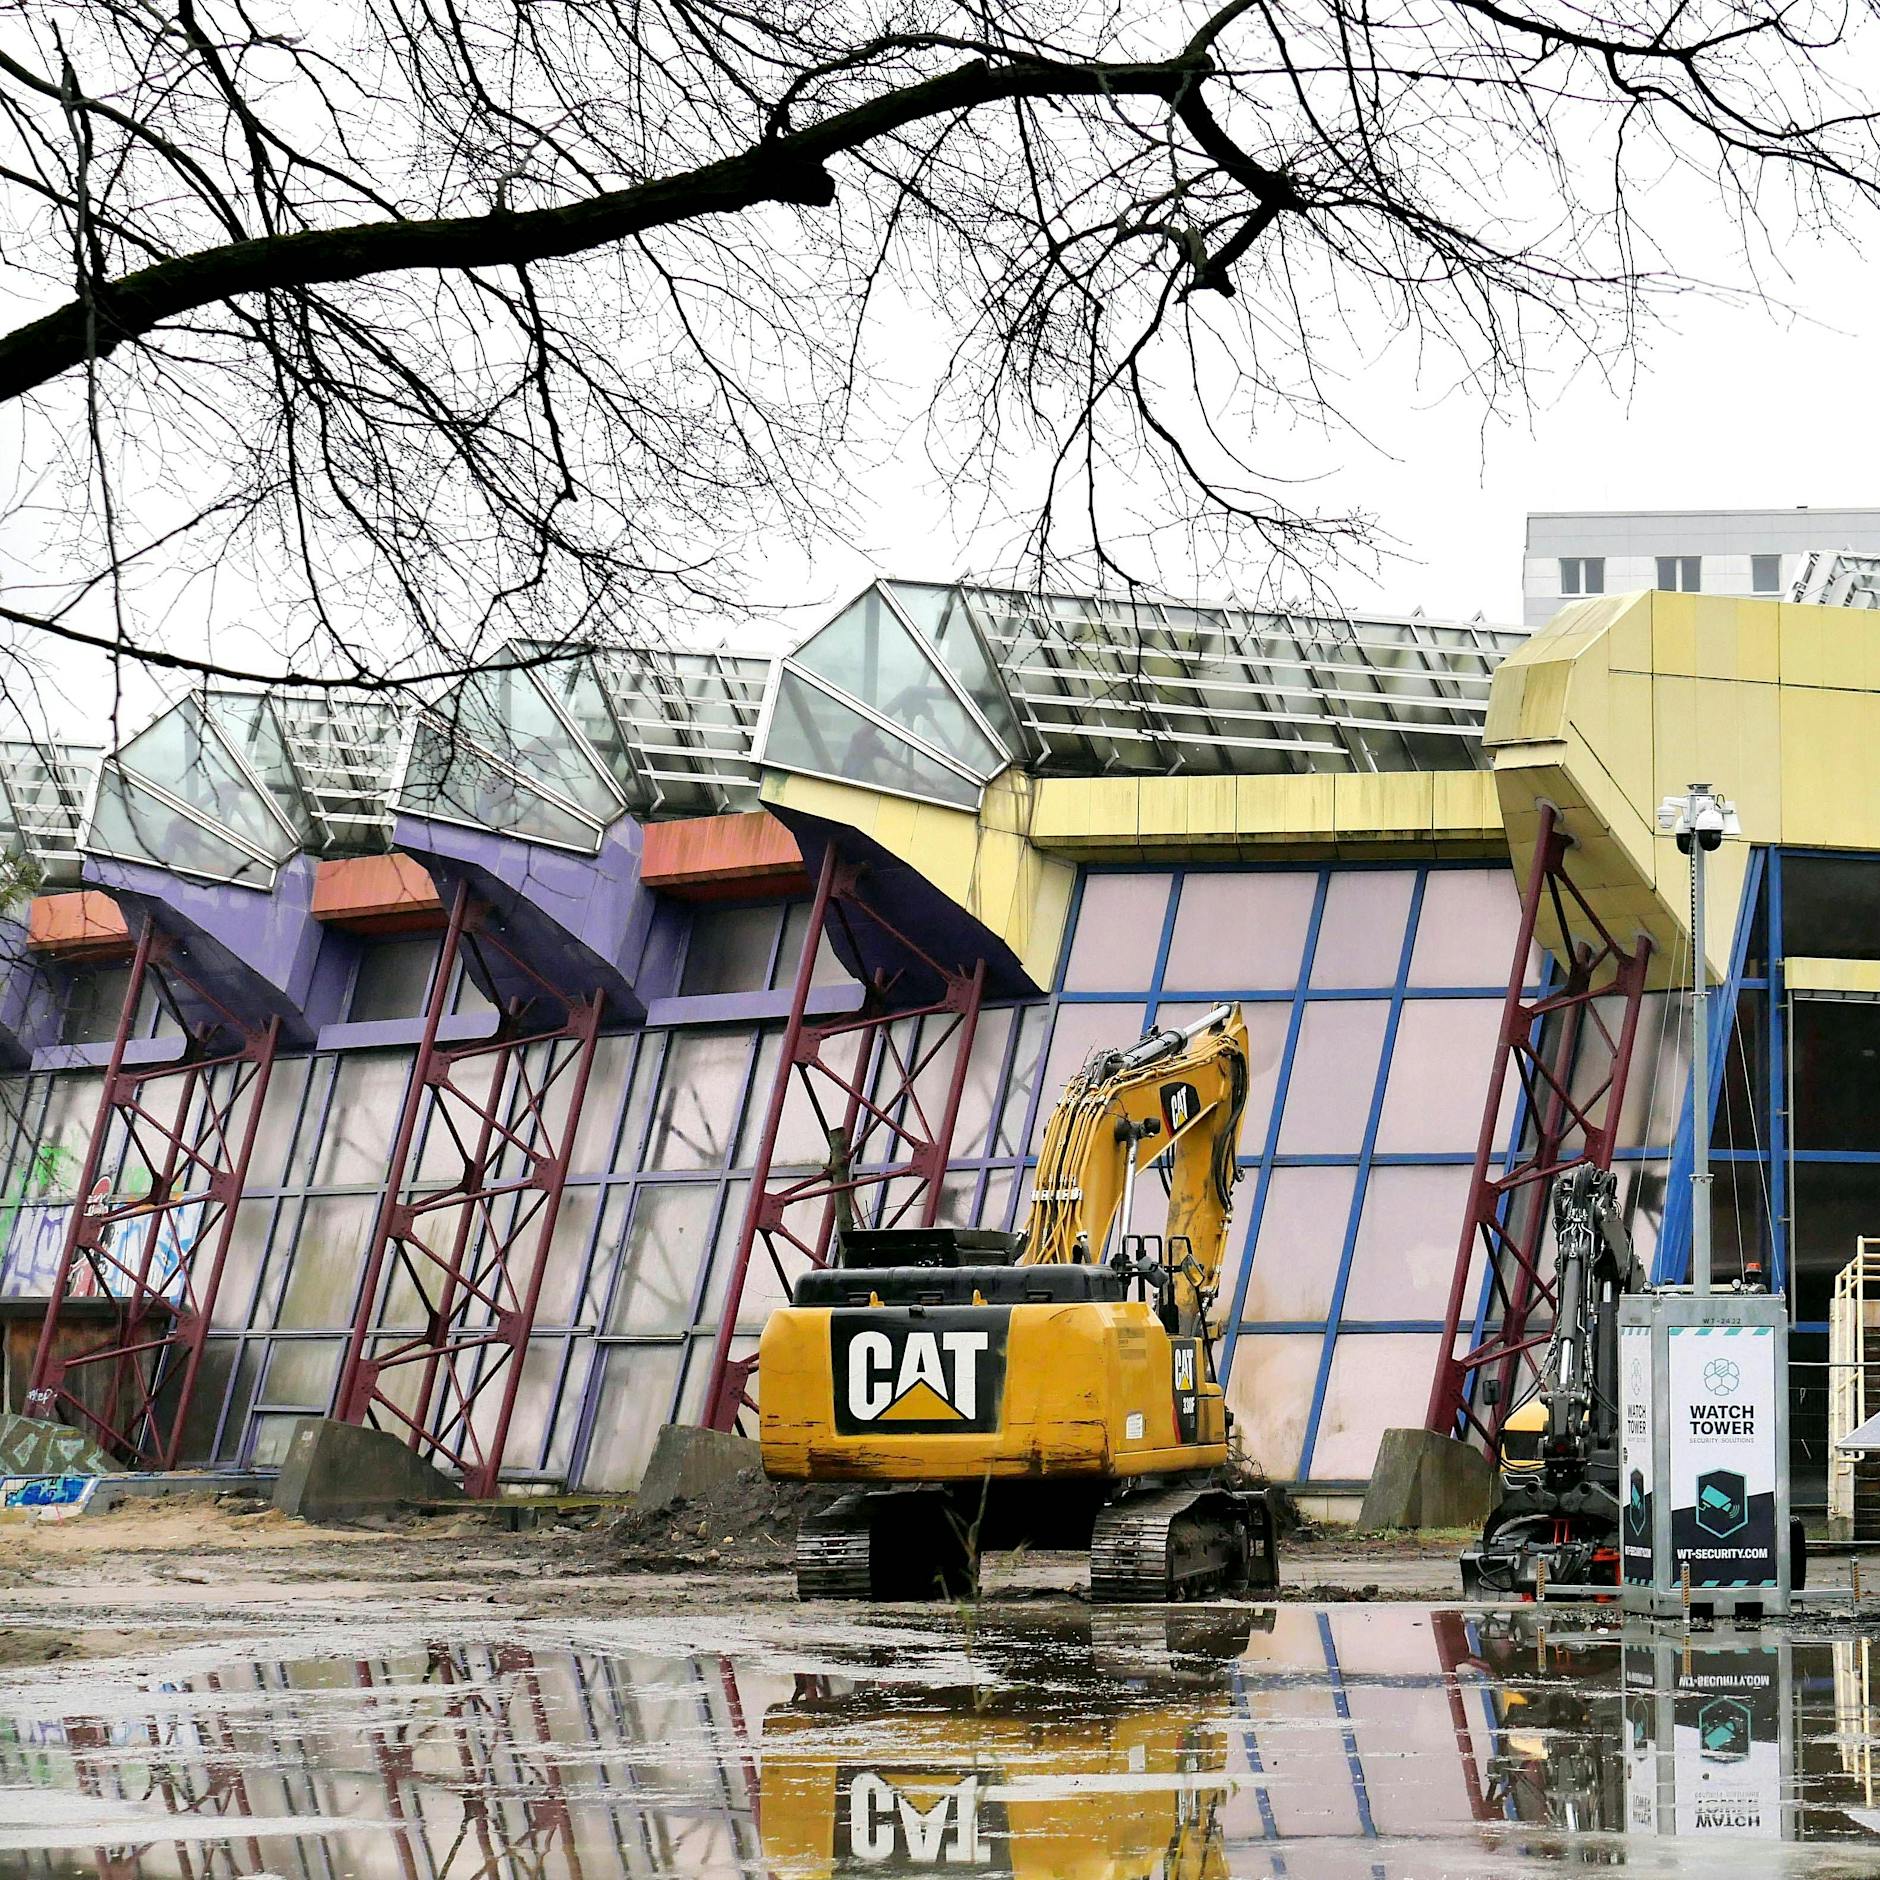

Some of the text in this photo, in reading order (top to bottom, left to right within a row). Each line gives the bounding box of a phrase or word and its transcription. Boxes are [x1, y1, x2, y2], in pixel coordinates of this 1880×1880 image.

[1171, 1085, 1188, 1130] CAT
[849, 1331, 989, 1421] CAT
[1174, 1348, 1194, 1391] CAT
[1689, 1405, 1755, 1419] WATCH
[1627, 1420, 1647, 1434] TOWER
[1689, 1421, 1755, 1435] TOWER
[1676, 1547, 1769, 1560] WT-SECURITY.COM
